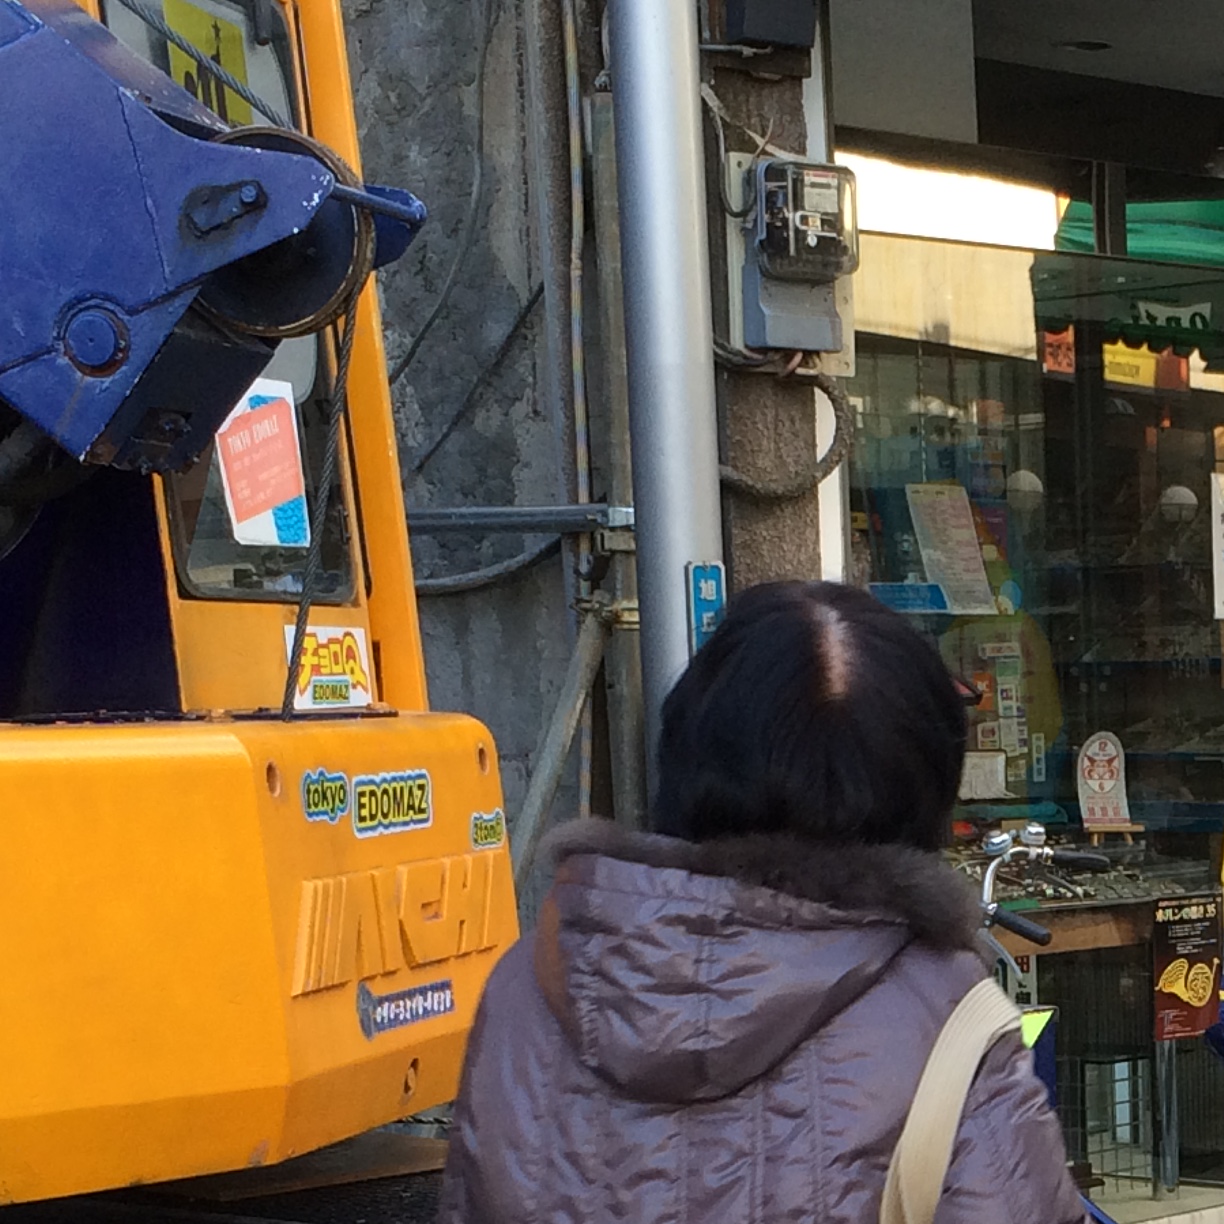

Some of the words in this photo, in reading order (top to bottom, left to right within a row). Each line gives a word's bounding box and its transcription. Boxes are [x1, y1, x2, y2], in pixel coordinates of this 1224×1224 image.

[298, 631, 369, 697] チョロQ
[313, 684, 349, 701] EDOMAZ
[305, 779, 347, 813] tokyo
[357, 783, 427, 823] EDOMAZ
